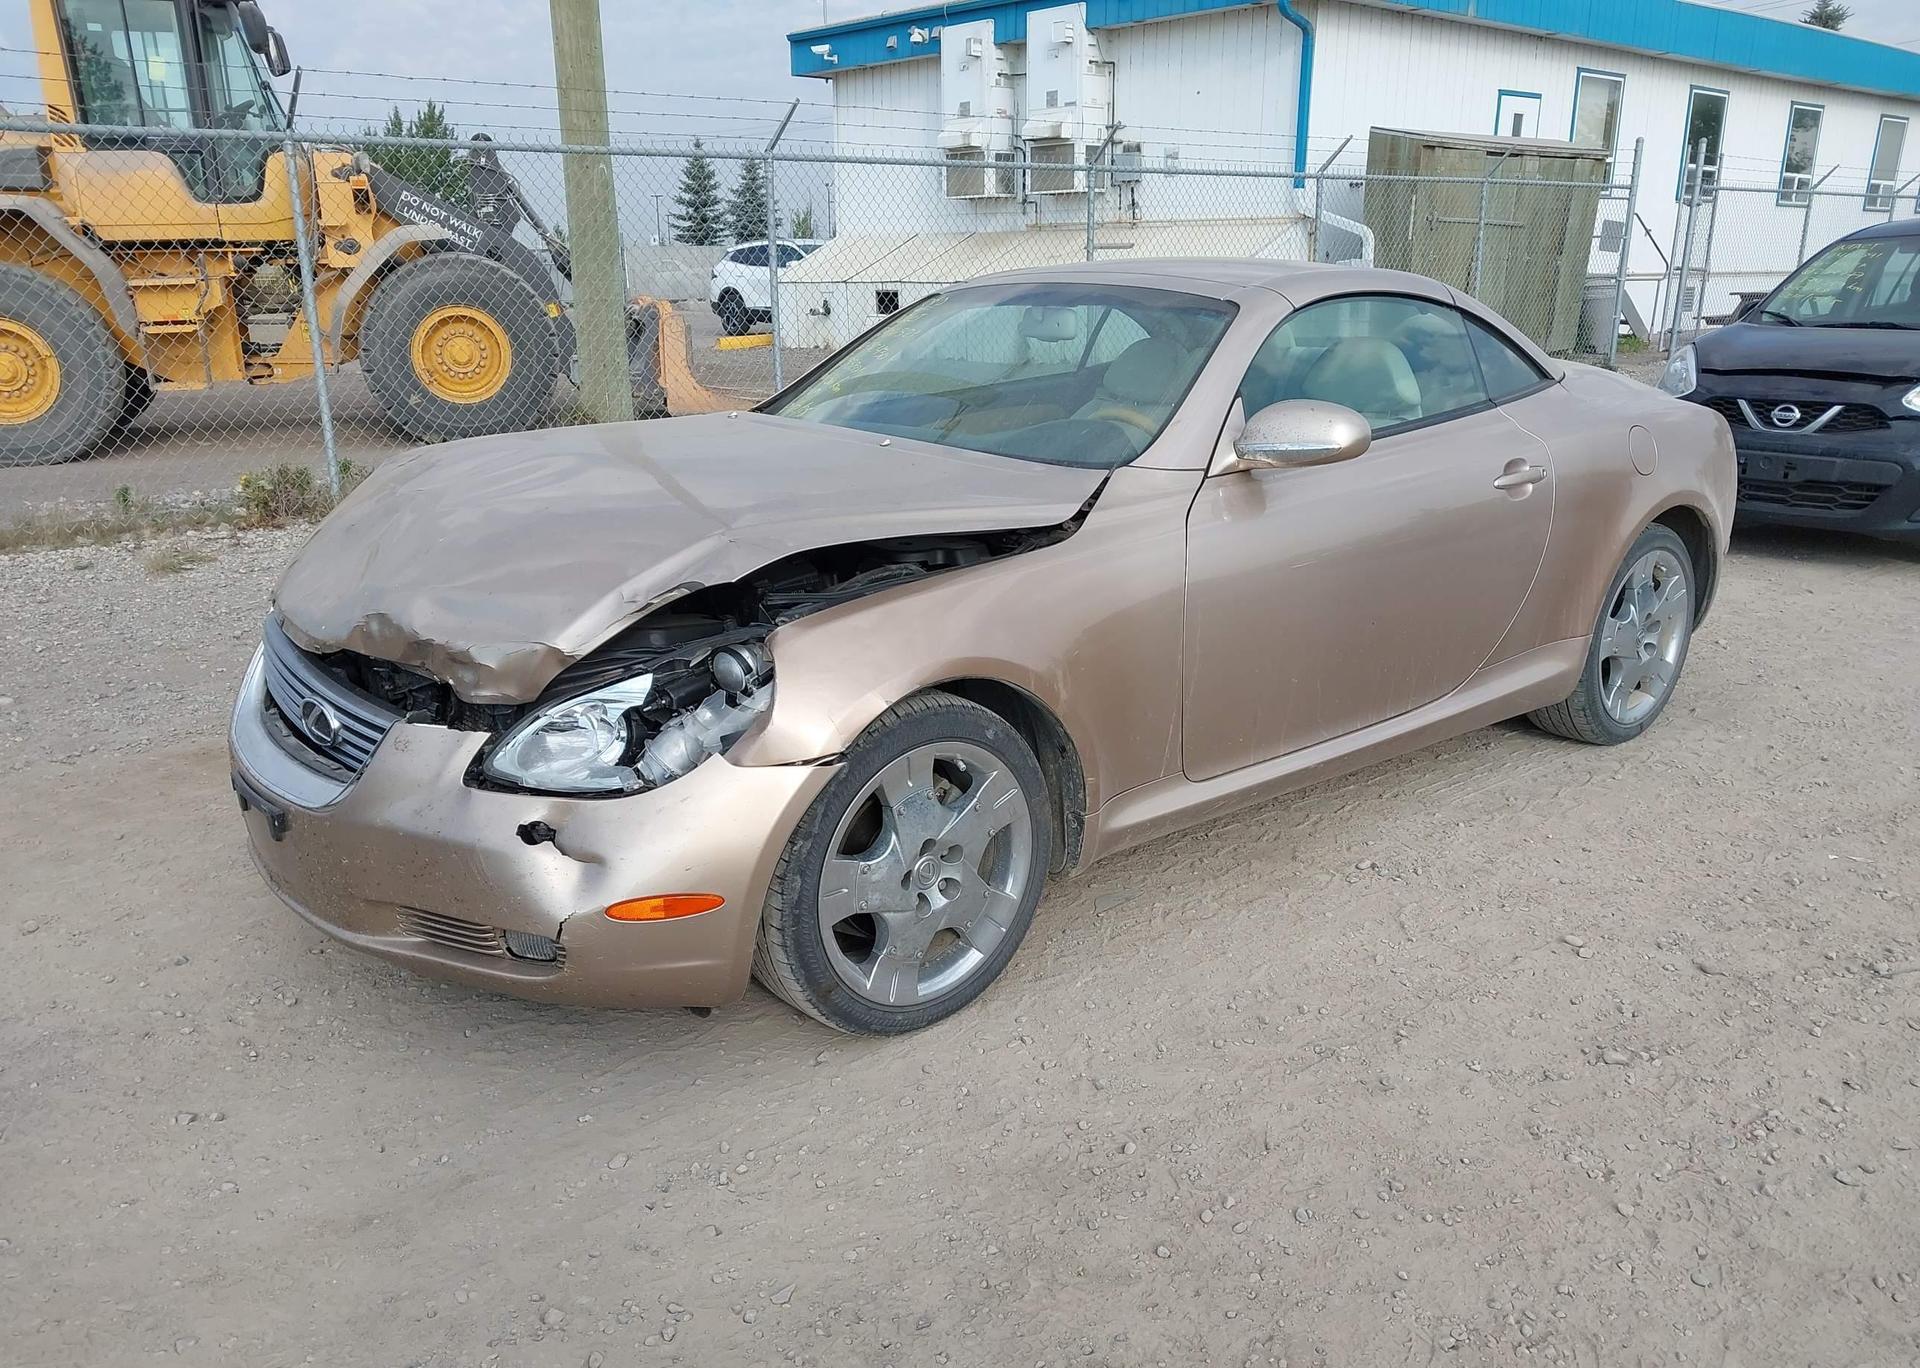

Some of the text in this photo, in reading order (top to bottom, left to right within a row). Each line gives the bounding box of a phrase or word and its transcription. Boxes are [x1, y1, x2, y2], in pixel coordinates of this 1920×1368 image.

[401, 191, 481, 238] DO NOT WALK
